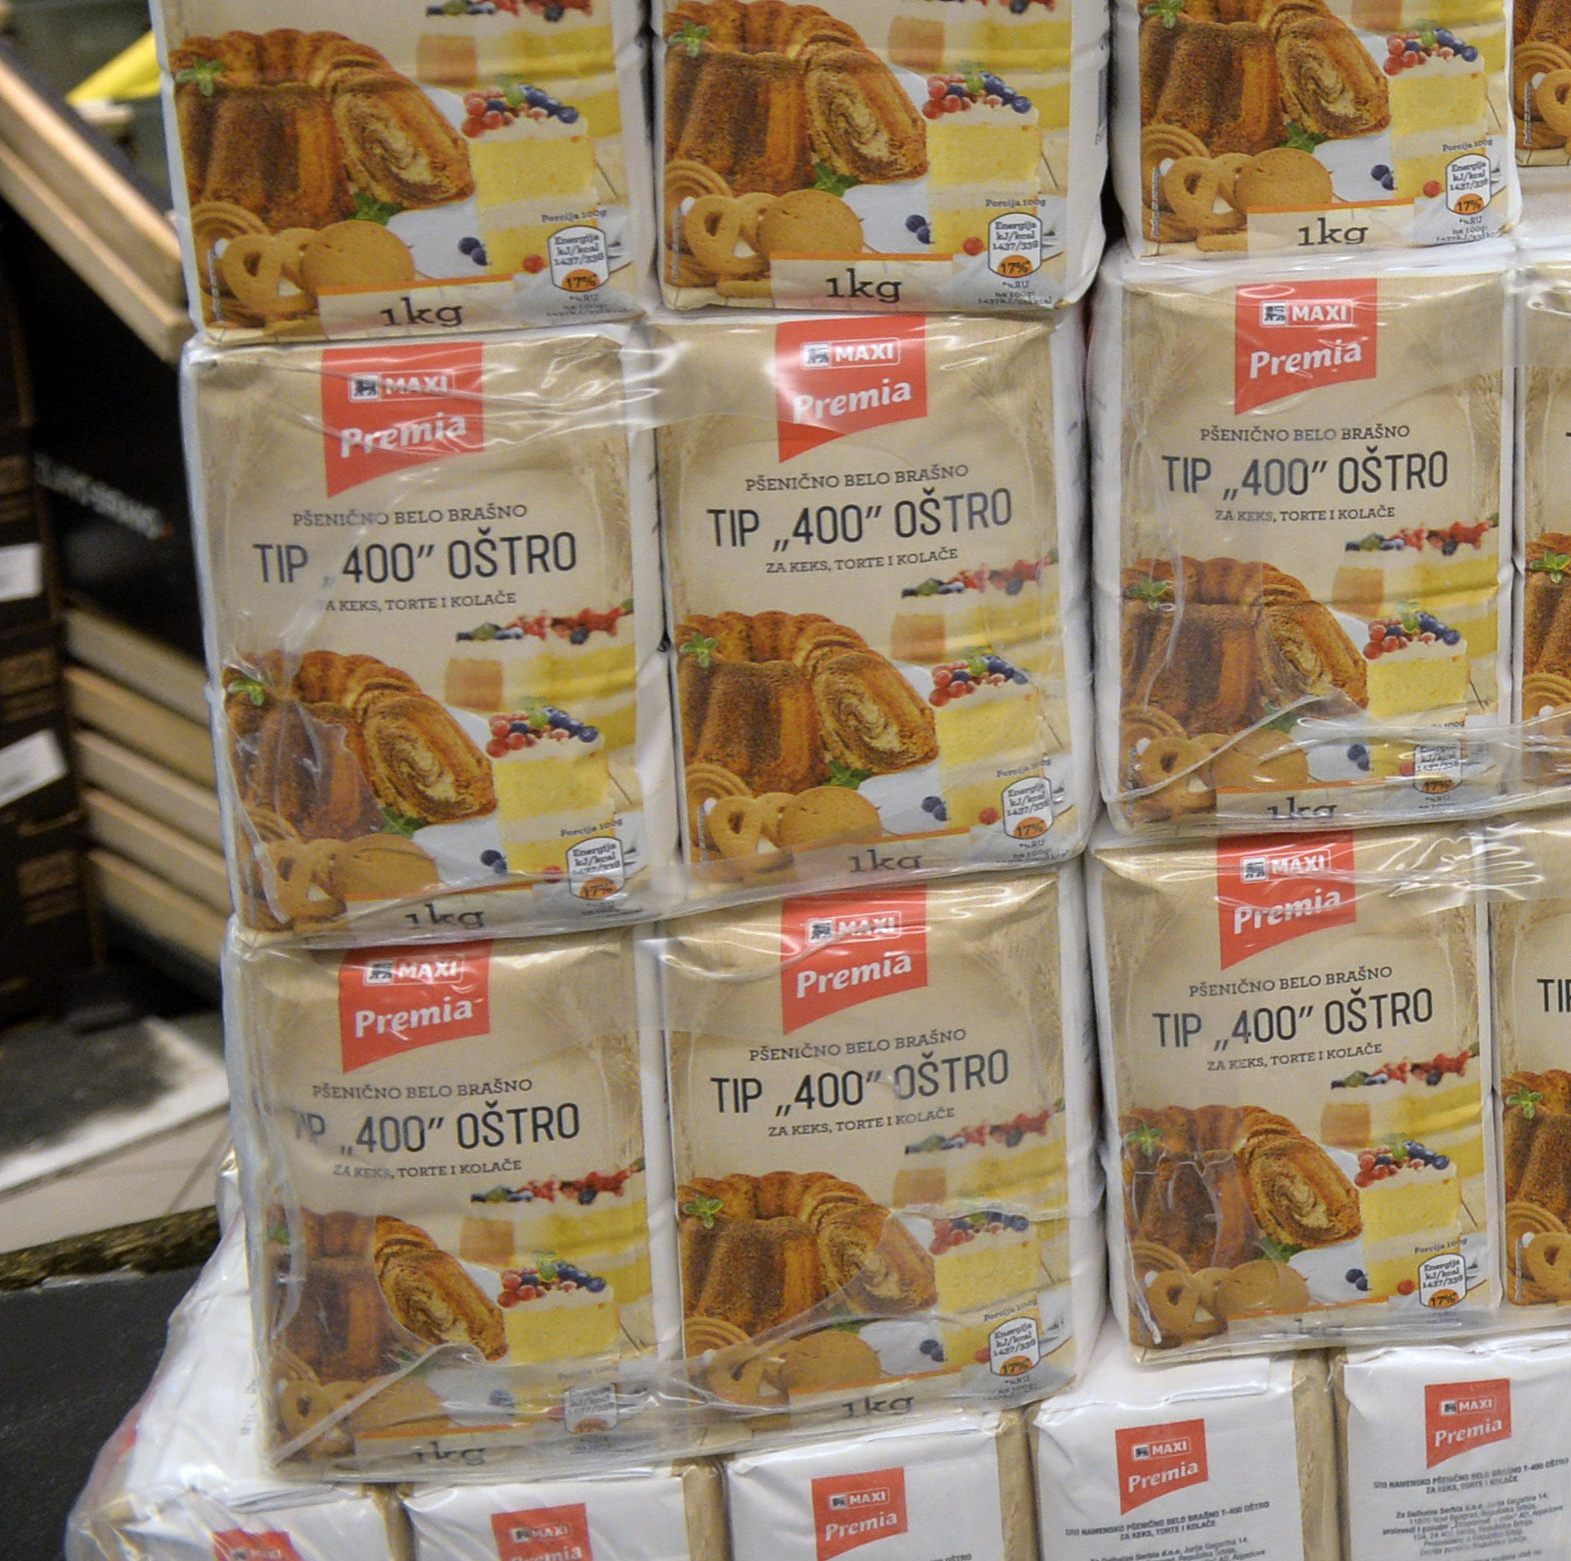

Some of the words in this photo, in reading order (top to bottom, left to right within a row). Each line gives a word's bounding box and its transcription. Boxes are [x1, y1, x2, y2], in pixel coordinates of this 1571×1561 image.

[985, 199, 1020, 208] Porcija
[826, 268, 902, 302] 1kg
[380, 297, 464, 327] 1kg
